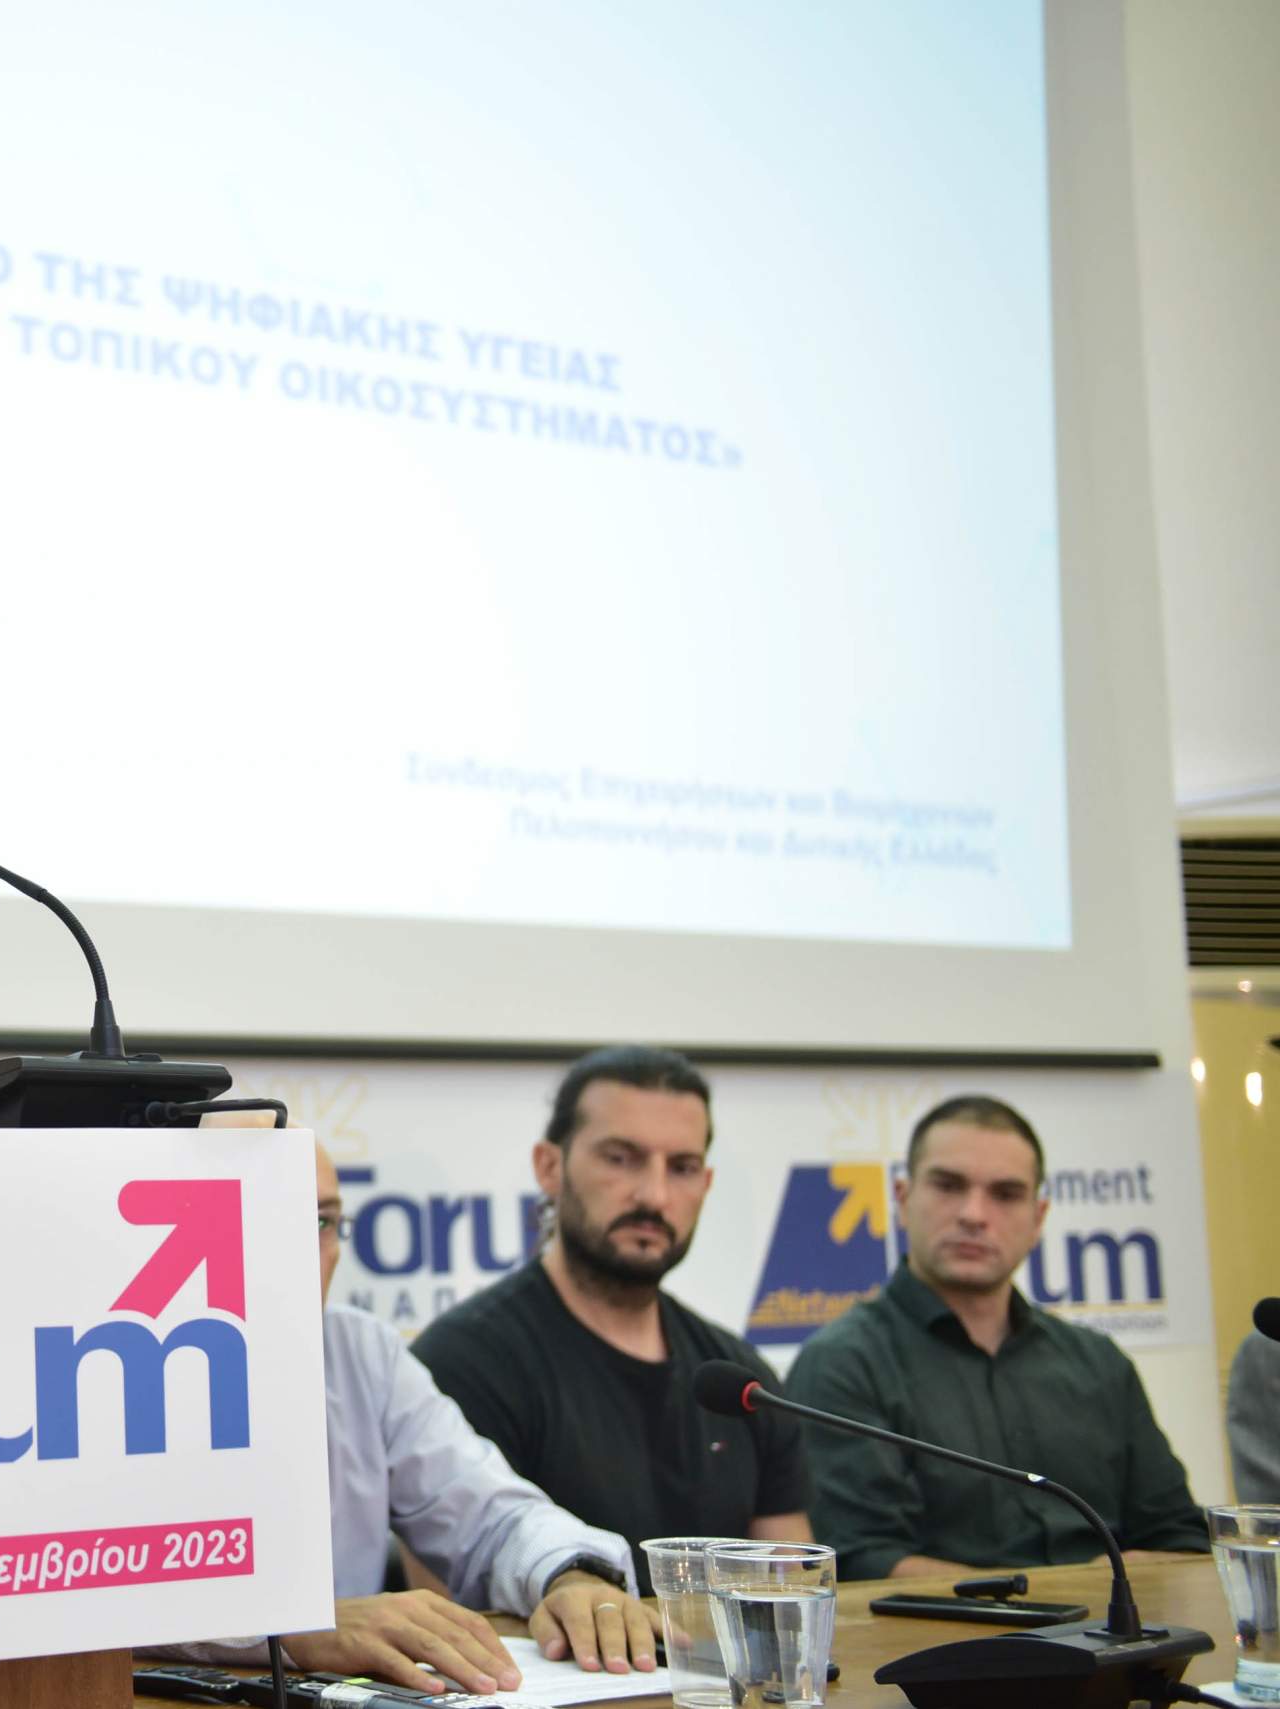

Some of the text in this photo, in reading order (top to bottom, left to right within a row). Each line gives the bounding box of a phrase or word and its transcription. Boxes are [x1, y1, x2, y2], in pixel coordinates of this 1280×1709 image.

[11, 312, 259, 391] ΤΟΠΙΚΟΥ
[35, 251, 142, 308] ΤΗΣ
[161, 273, 441, 361] ΨΗΦΙΑΚΗΣ
[458, 328, 622, 394] ΥΓΕΙΑΣ
[162, 1527, 248, 1569] 2023
